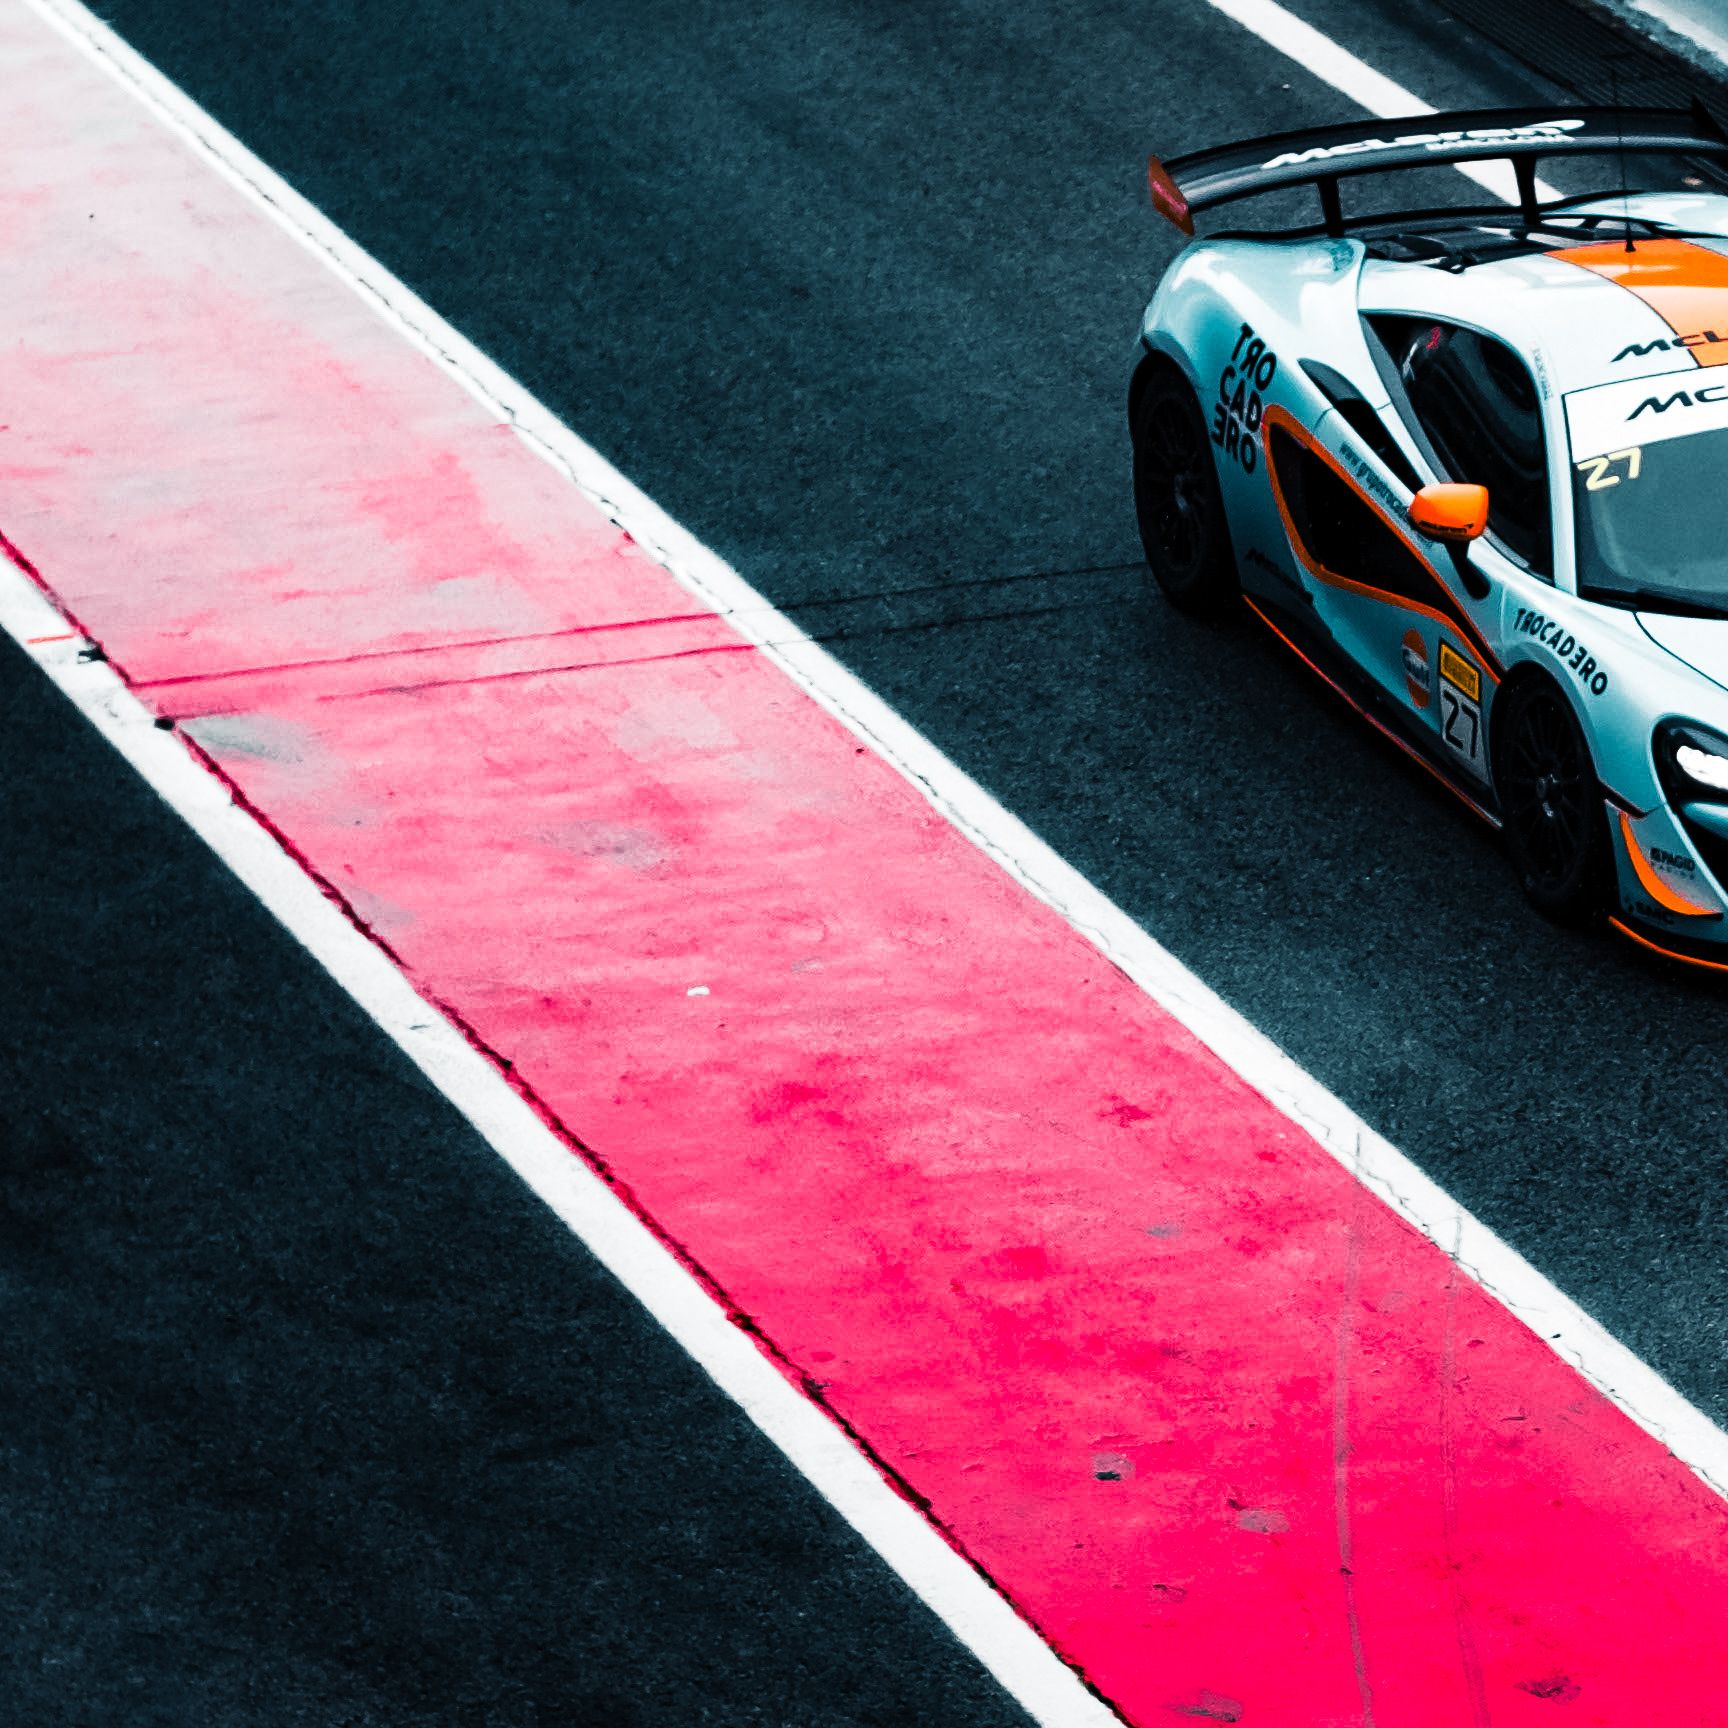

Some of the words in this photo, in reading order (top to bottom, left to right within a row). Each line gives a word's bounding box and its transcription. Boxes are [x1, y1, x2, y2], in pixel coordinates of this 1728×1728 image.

[1219, 365, 1262, 432] CAD
[1577, 446, 1641, 491] 27
[1513, 607, 1608, 696] TROCADERO
[1442, 689, 1478, 759] 27
